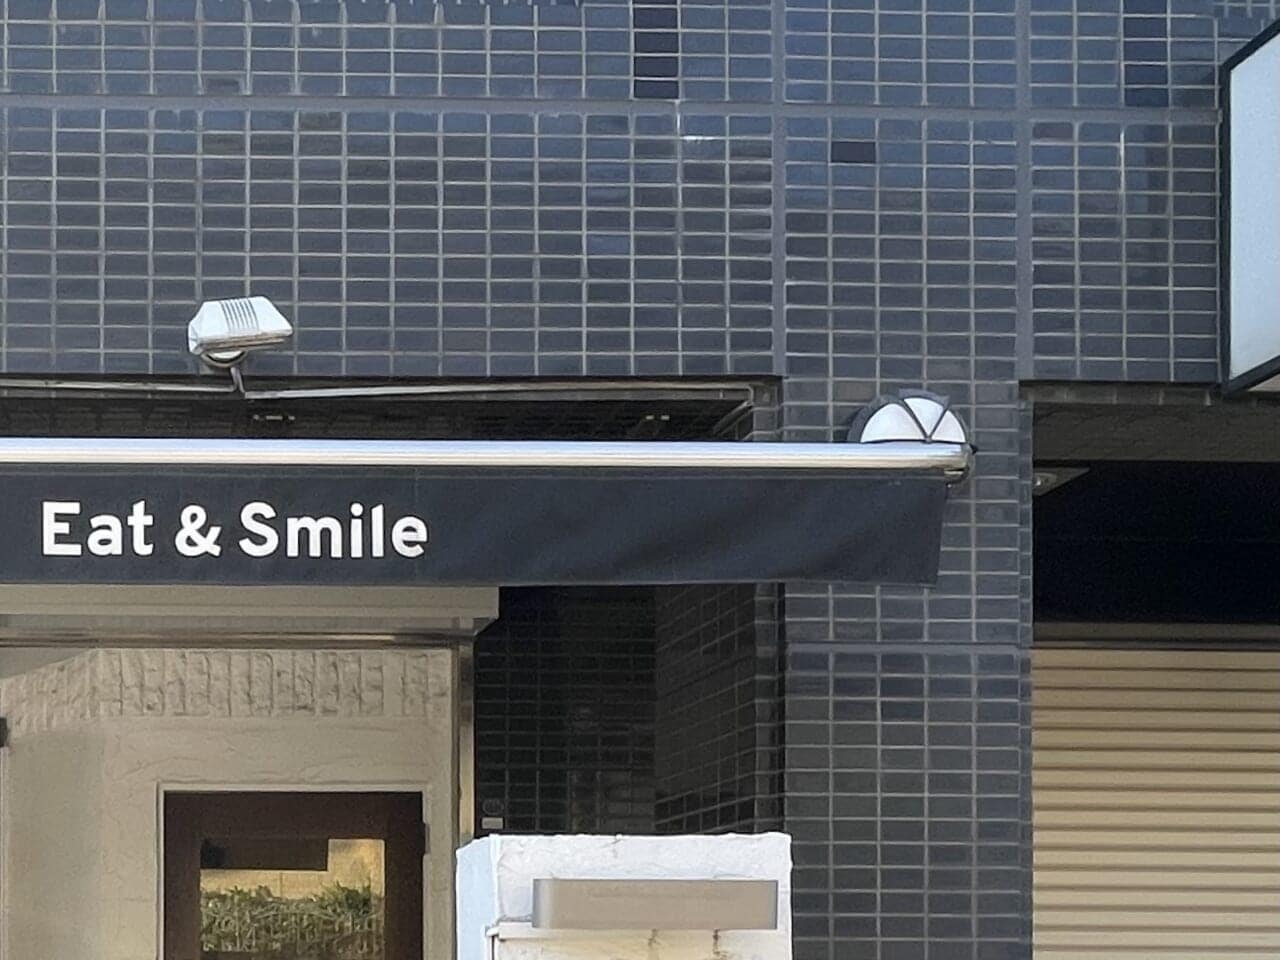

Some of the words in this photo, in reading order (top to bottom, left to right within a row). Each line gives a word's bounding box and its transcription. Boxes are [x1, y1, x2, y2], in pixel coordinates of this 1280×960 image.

[42, 500, 154, 556] Eat
[175, 504, 221, 557] &
[238, 501, 428, 558] Smile
